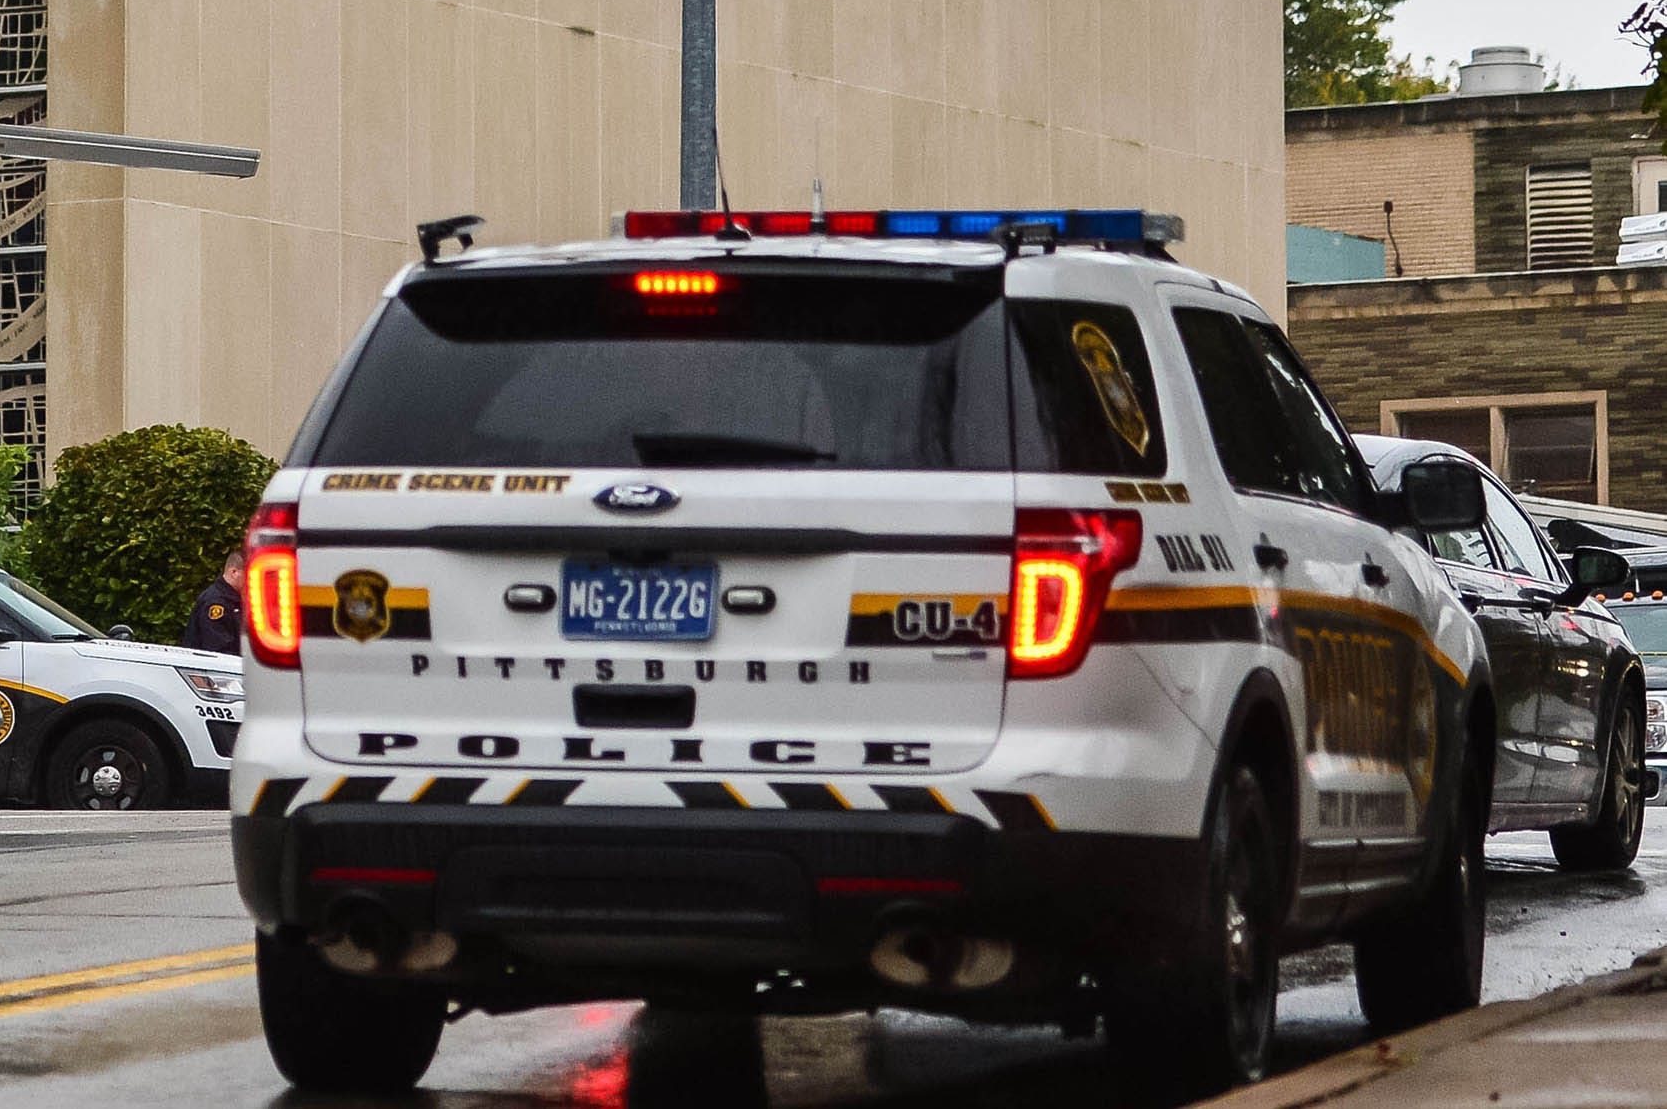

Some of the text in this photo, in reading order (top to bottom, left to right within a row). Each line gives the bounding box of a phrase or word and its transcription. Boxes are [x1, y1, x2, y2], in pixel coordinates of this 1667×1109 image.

[322, 473, 572, 493] CRIME SCENE UNIT
[894, 599, 1000, 641] CU-4
[411, 654, 871, 683] PITTSBURGH
[356, 732, 933, 766] POLICE
